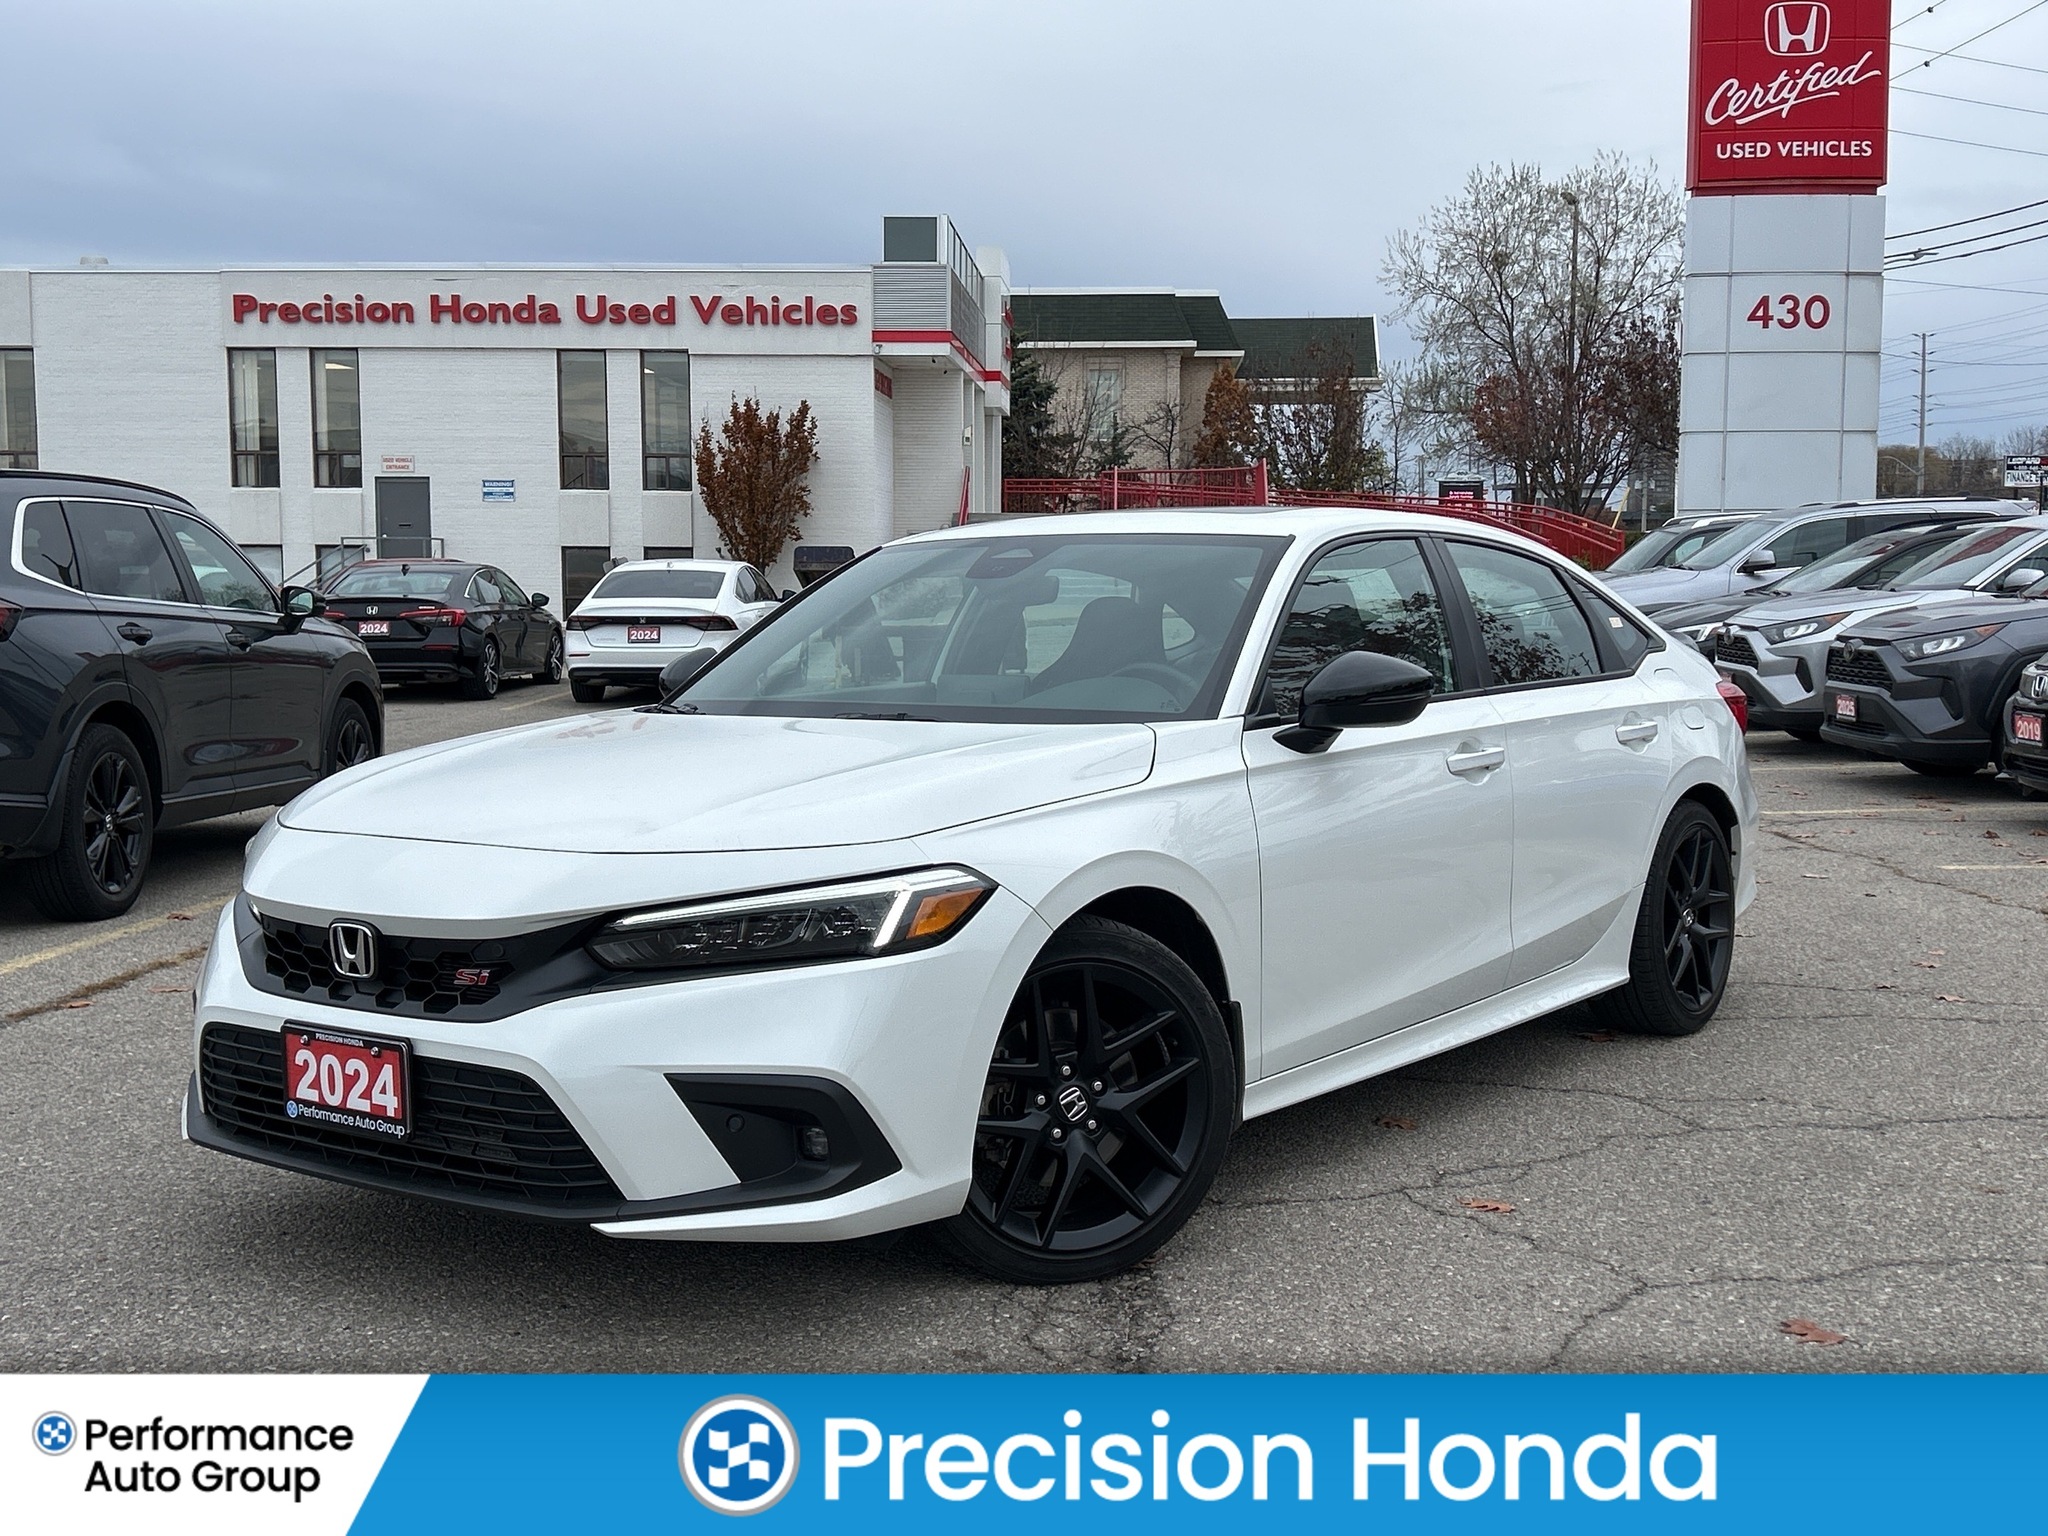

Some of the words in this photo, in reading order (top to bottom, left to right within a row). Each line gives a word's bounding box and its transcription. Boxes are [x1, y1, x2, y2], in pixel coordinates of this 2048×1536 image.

[1705, 50, 1882, 127] Certified
[1716, 141, 1772, 160] USED
[1777, 140, 1873, 159] VEHICLES
[233, 293, 414, 323] Precision
[430, 294, 561, 324] Honda
[576, 294, 676, 325] Used
[690, 295, 858, 326] Vehicles
[1747, 294, 1831, 330] 430
[2008, 457, 2041, 465] LEOPARD
[360, 623, 389, 634] 2024
[630, 630, 659, 640] 2024
[2016, 720, 2041, 741] 2019
[453, 968, 491, 986] Si
[315, 1032, 343, 1044] PRECISION
[343, 1037, 364, 1048] HONDA
[294, 1048, 399, 1118] 2024
[298, 1103, 354, 1126] Performance
[354, 1115, 376, 1131] Auto
[376, 1119, 405, 1139] Group
